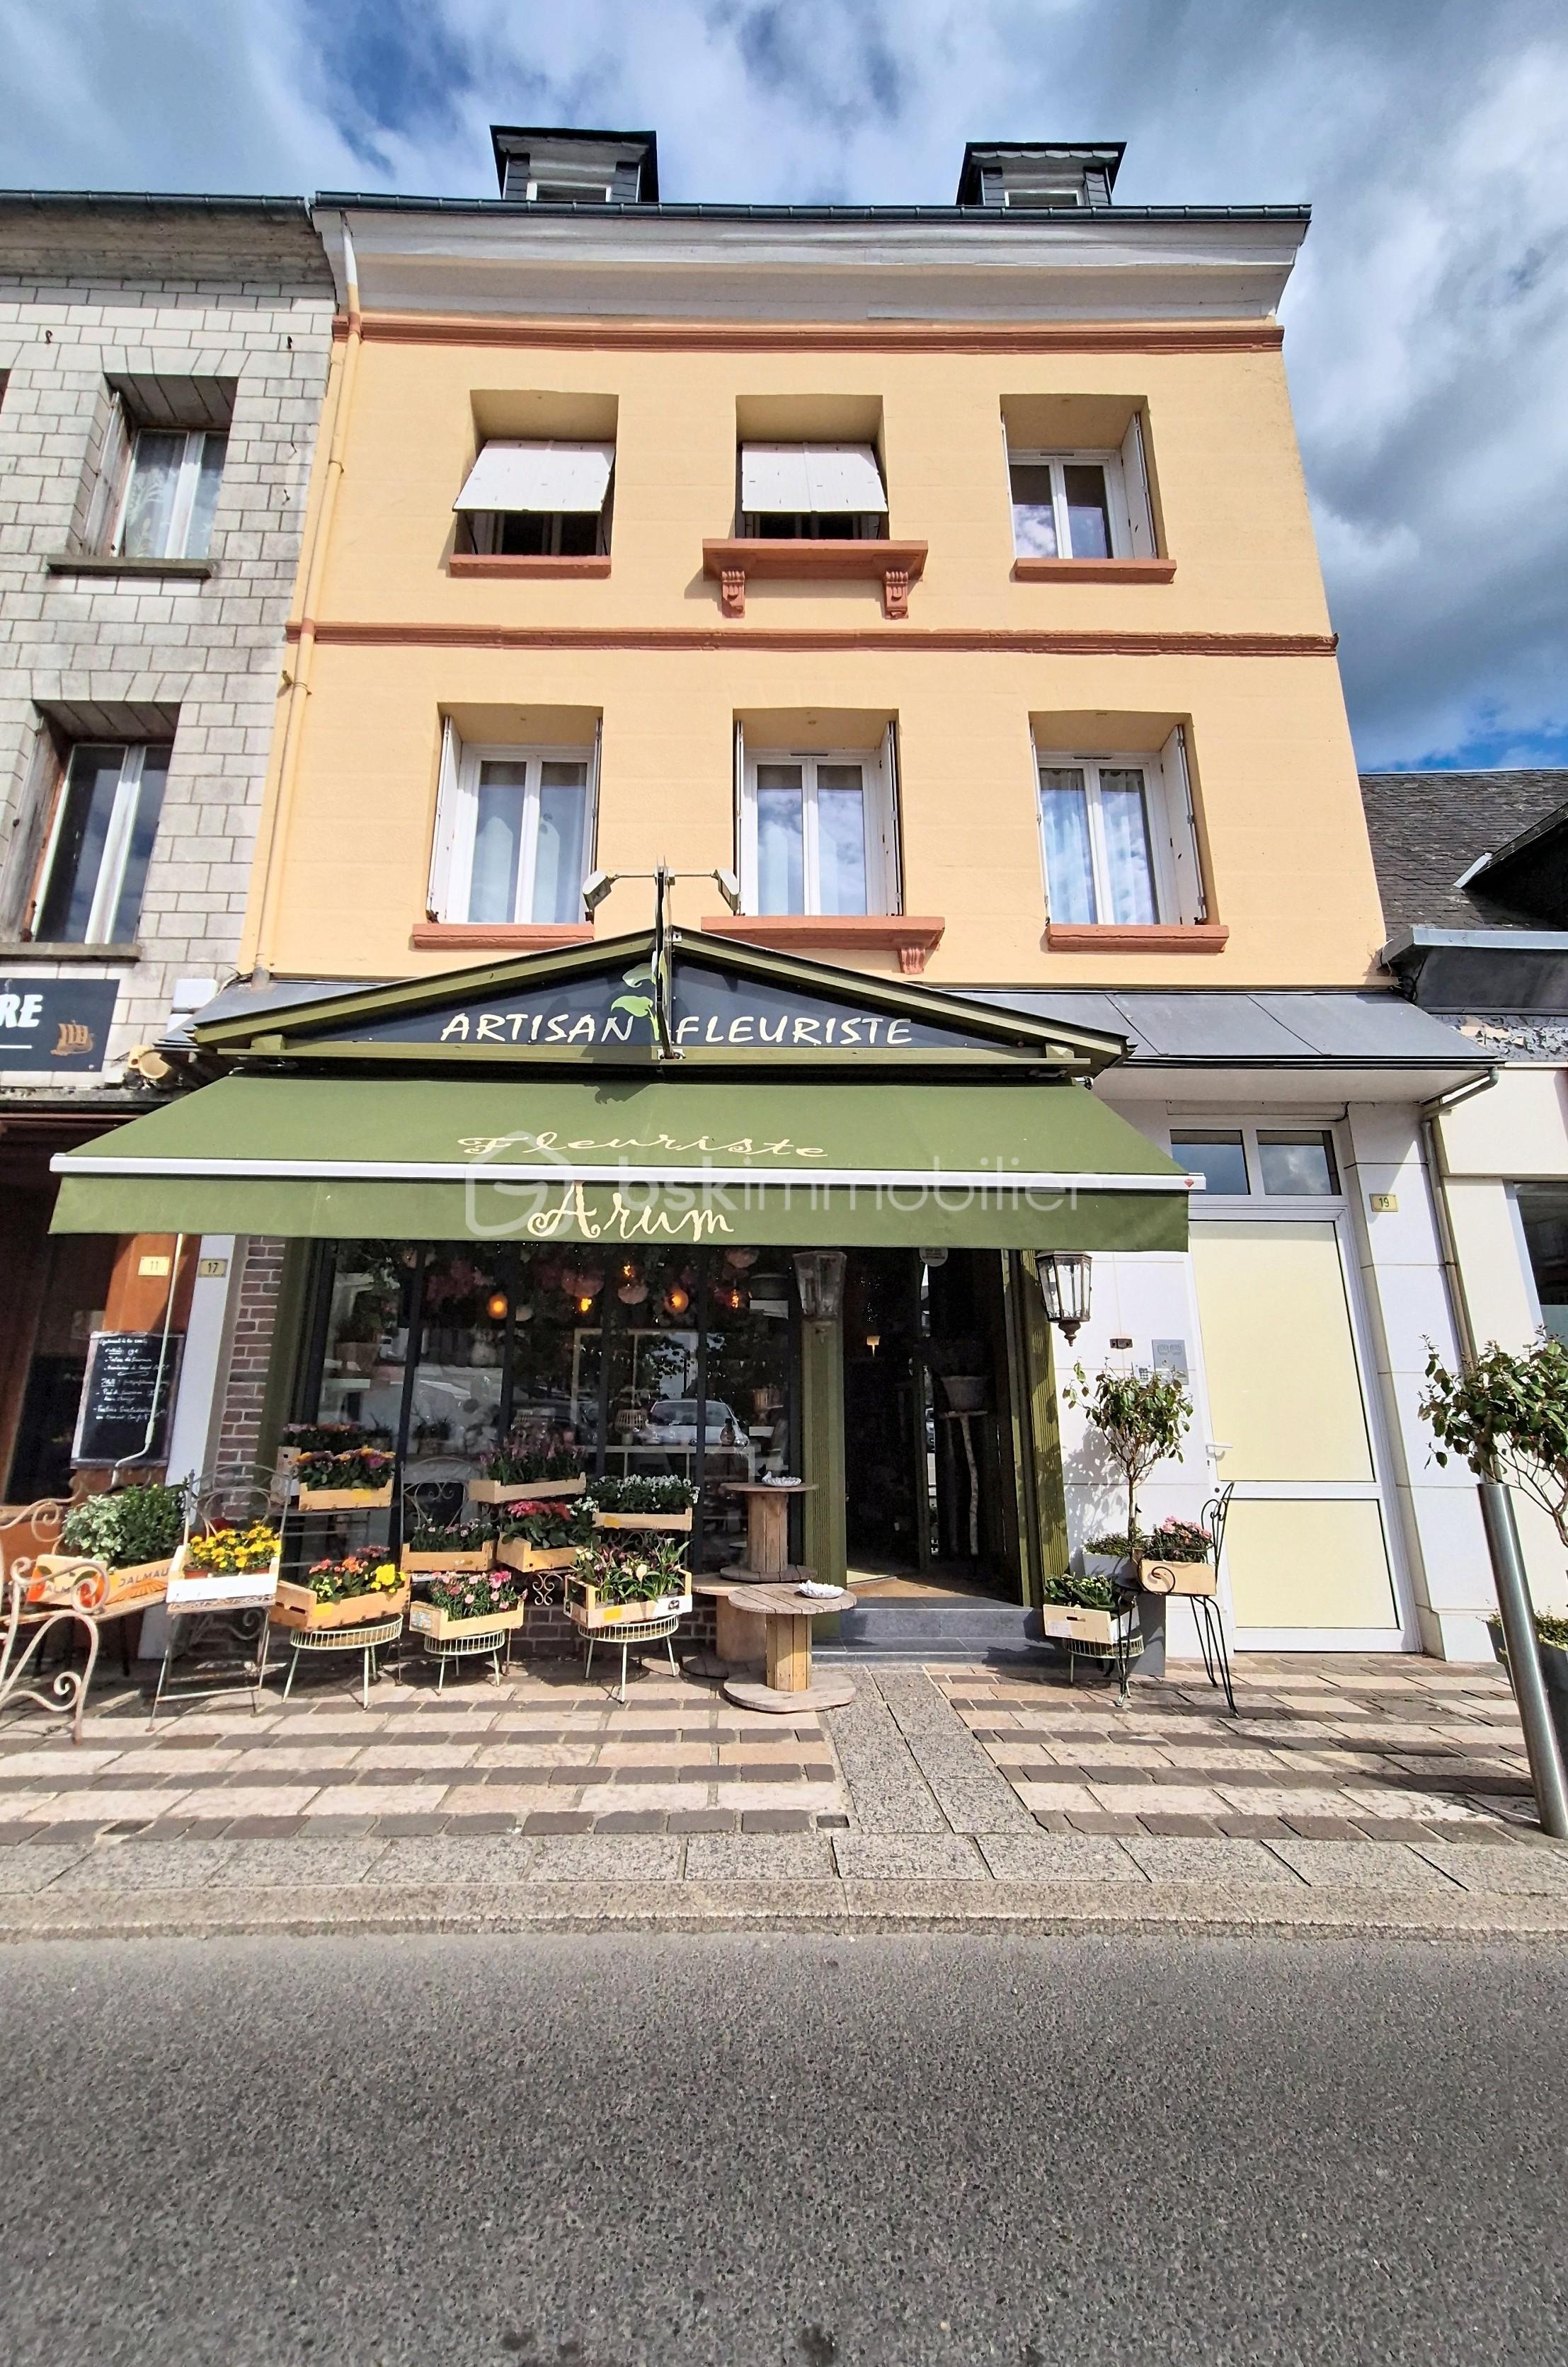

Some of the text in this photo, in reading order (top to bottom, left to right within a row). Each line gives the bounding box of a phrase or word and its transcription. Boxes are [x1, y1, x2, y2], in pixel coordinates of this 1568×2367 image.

[440, 1013, 912, 1045] ARTISAN FLEURISTE
[457, 1132, 828, 1157] Fleuriste
[527, 1180, 735, 1242] Arum
[1378, 1197, 1390, 1208] 19
[207, 1262, 218, 1273] 17
